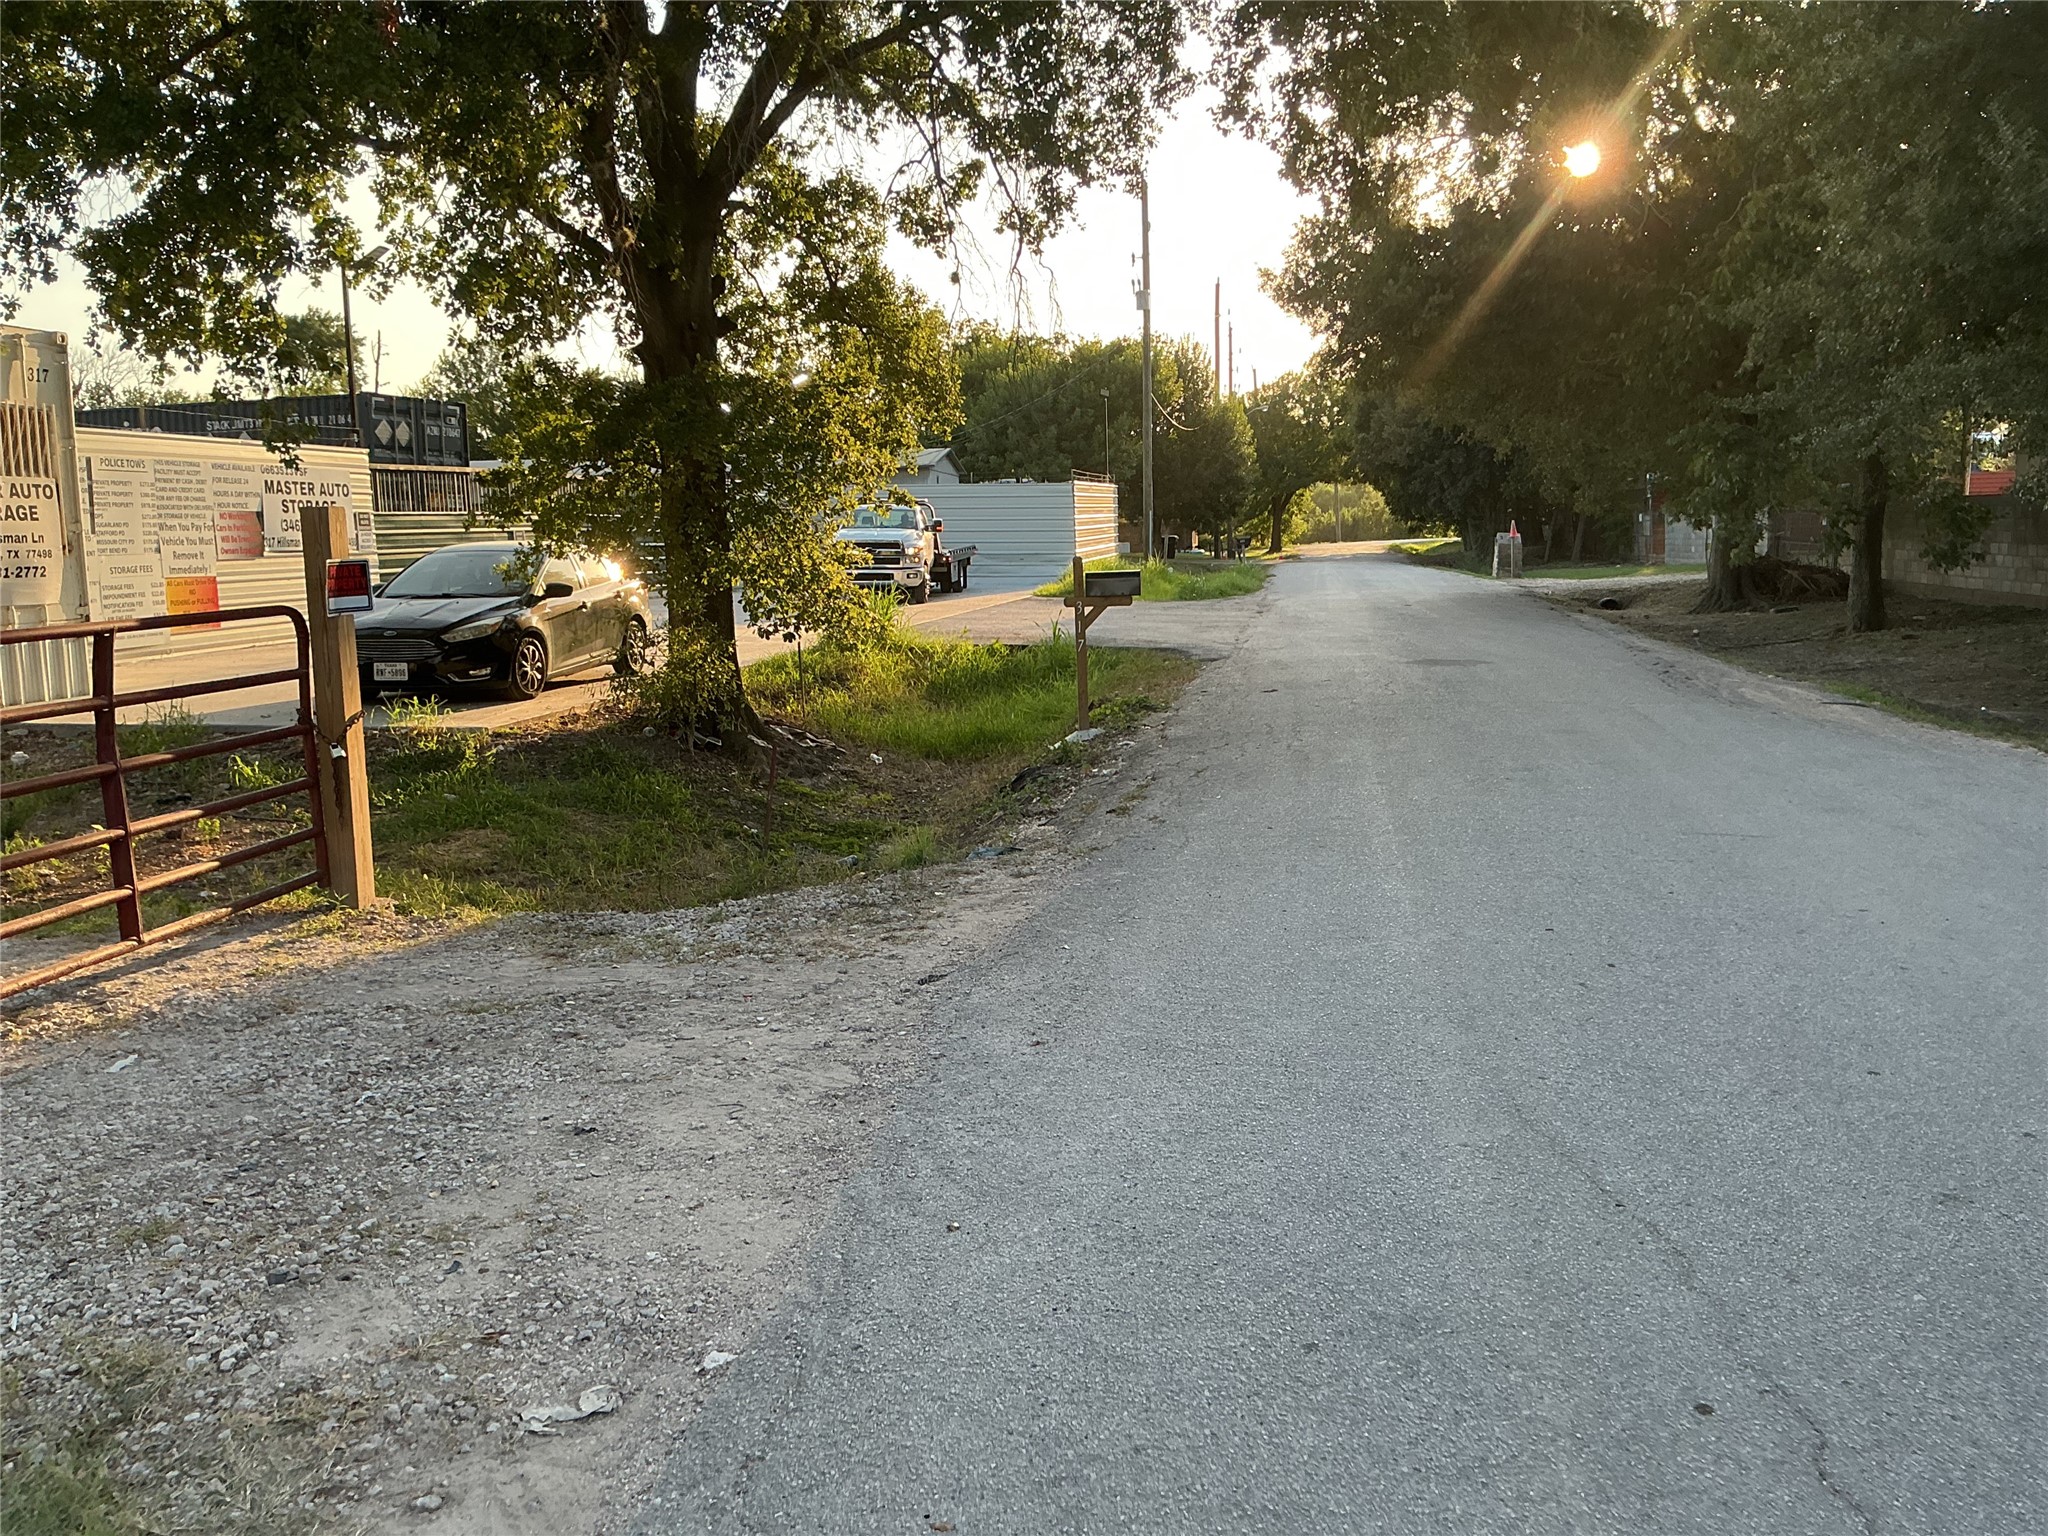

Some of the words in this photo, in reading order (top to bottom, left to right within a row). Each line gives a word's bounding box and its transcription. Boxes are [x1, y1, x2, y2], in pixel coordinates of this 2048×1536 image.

[27, 367, 49, 382] 317
[100, 458, 125, 468] POLICE
[126, 459, 146, 469] TOWS
[9, 482, 54, 500] AUTO
[264, 480, 315, 496] MASTER
[320, 483, 350, 497] AUTO
[157, 522, 177, 532] When
[178, 522, 190, 532] You
[191, 523, 202, 533] Pay
[203, 523, 214, 532] For
[31, 532, 44, 543] Ln
[161, 536, 184, 546] Vehicle
[185, 537, 198, 546] You
[7, 549, 20, 559] TX
[26, 549, 53, 559] 77498
[173, 551, 198, 560] Remove
[109, 566, 138, 575] STORAGE
[139, 565, 153, 573] FEES
